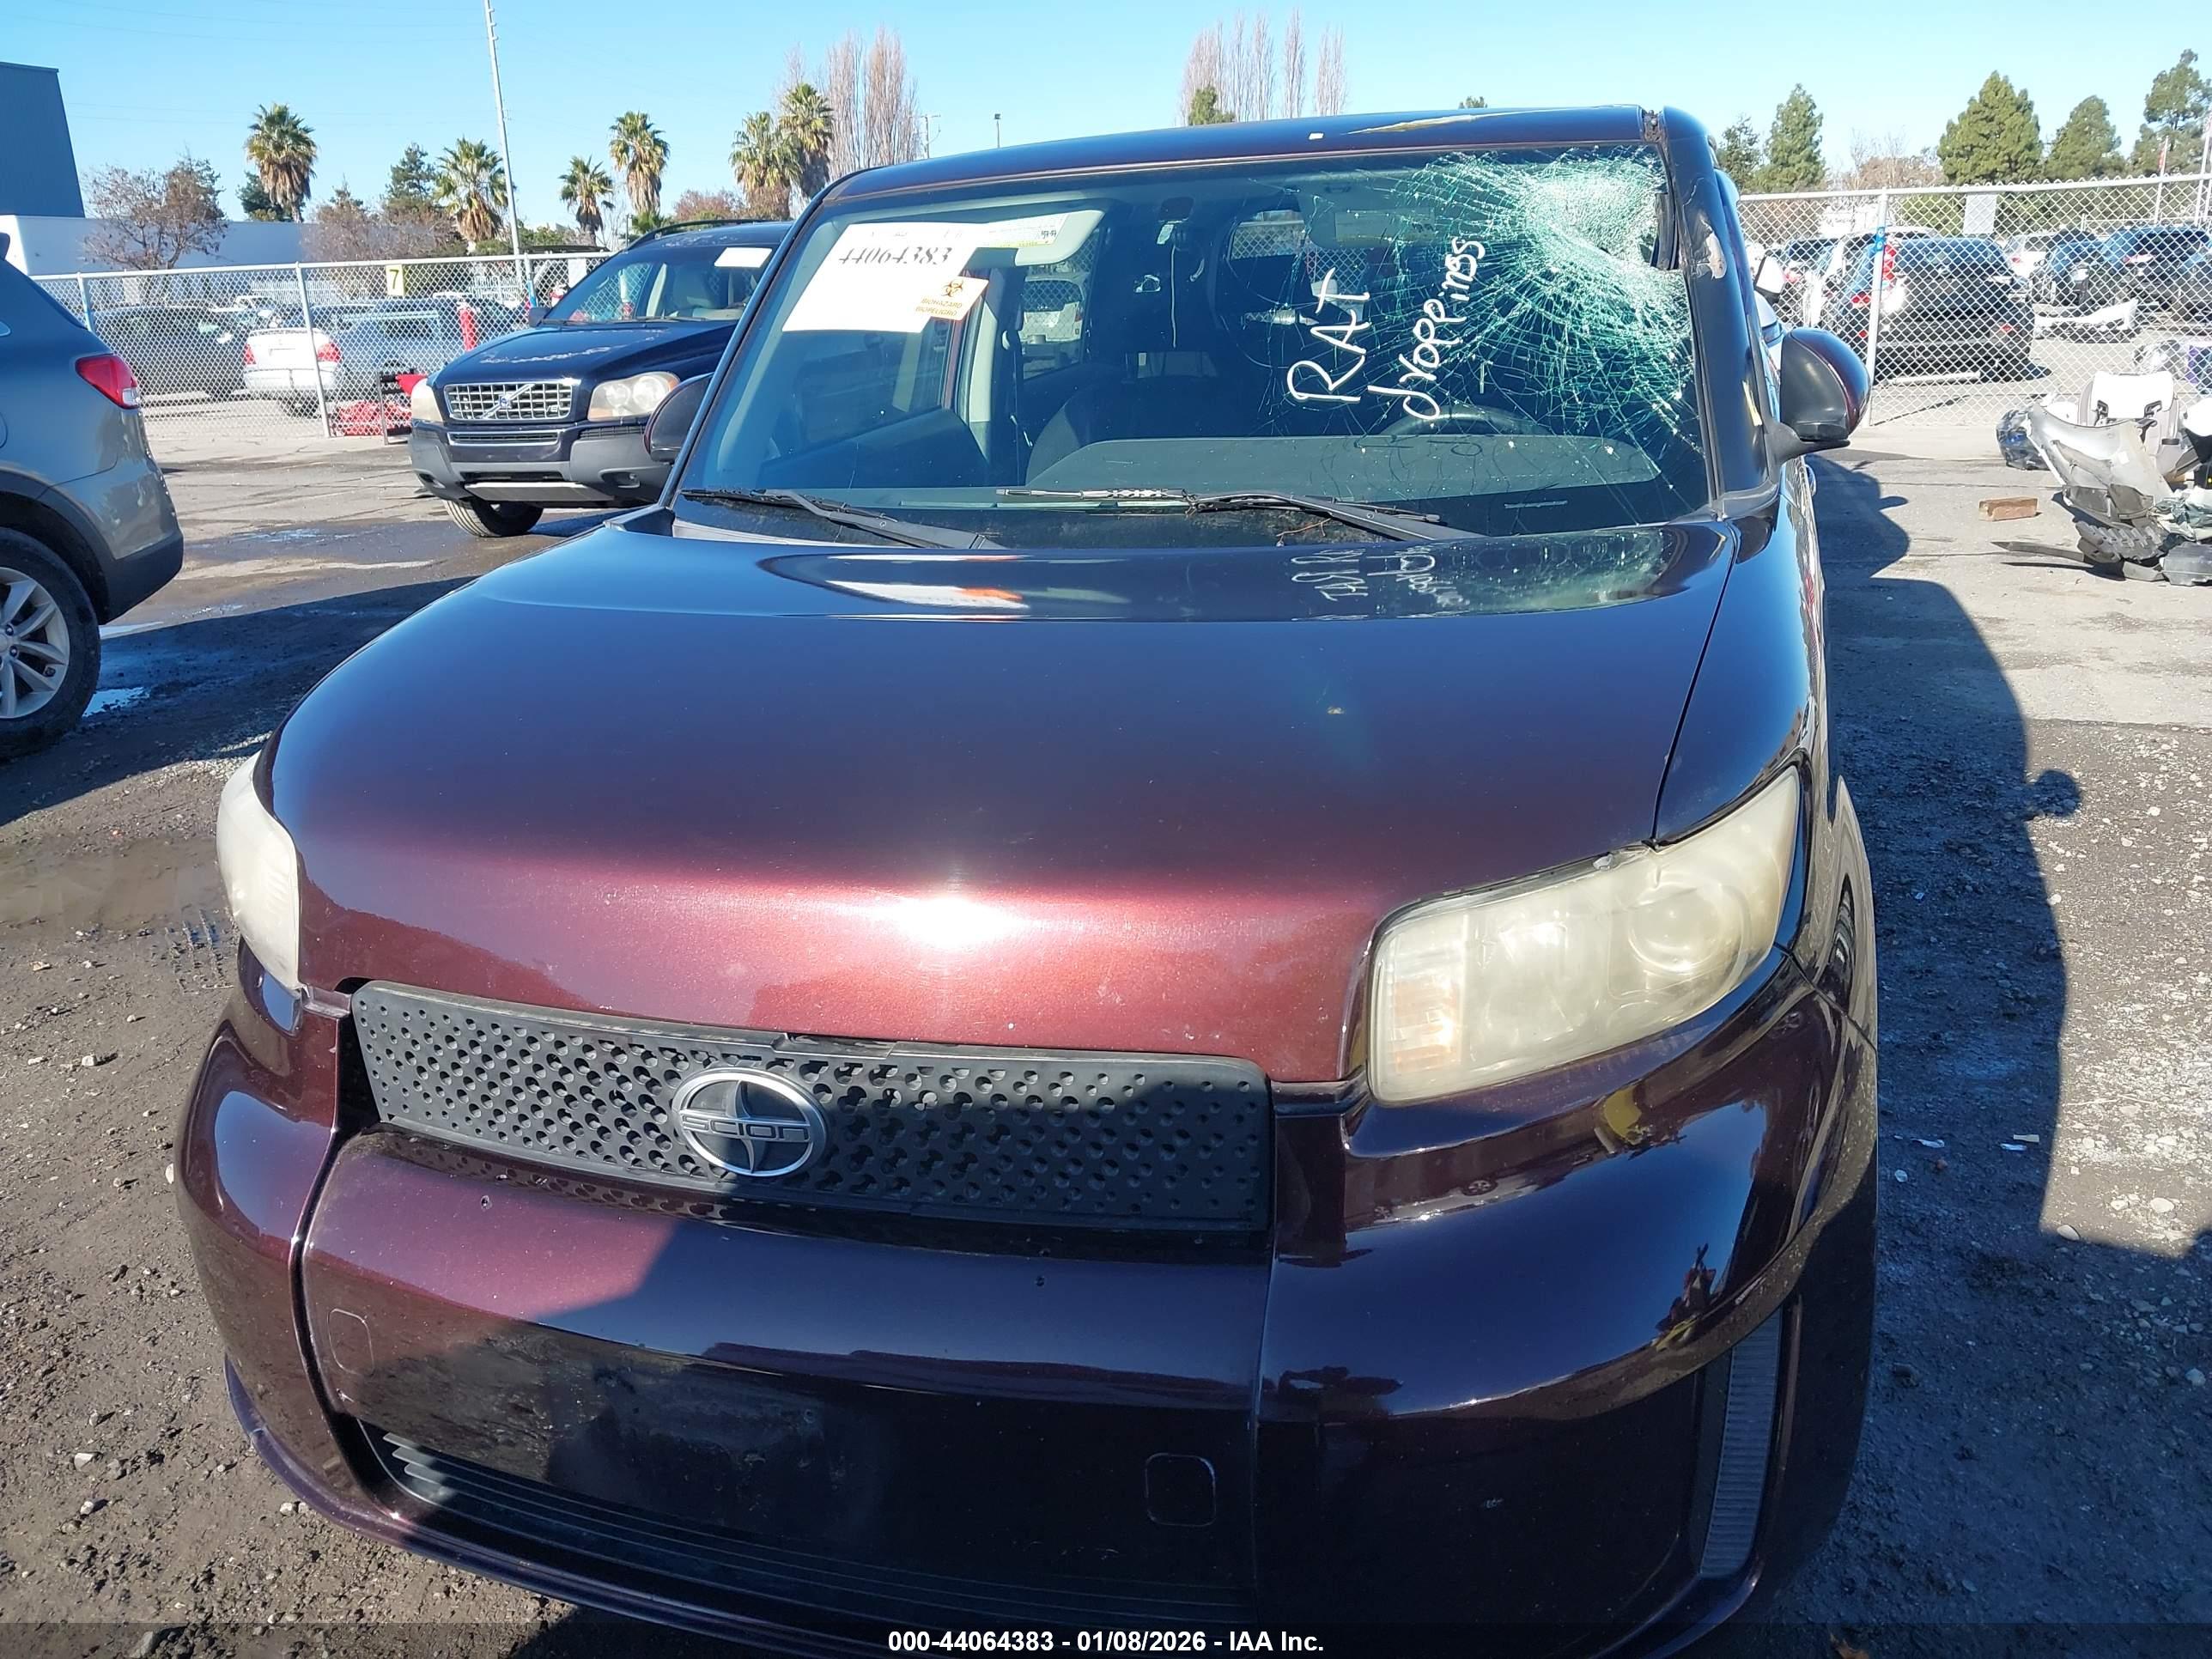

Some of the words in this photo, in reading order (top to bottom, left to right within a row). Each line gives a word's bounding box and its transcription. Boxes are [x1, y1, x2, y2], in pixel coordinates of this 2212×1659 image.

[838, 246, 952, 264] 44064383
[389, 269, 399, 289] 7
[921, 297, 963, 309] BIOHAZARD
[1286, 267, 1370, 402] RAT
